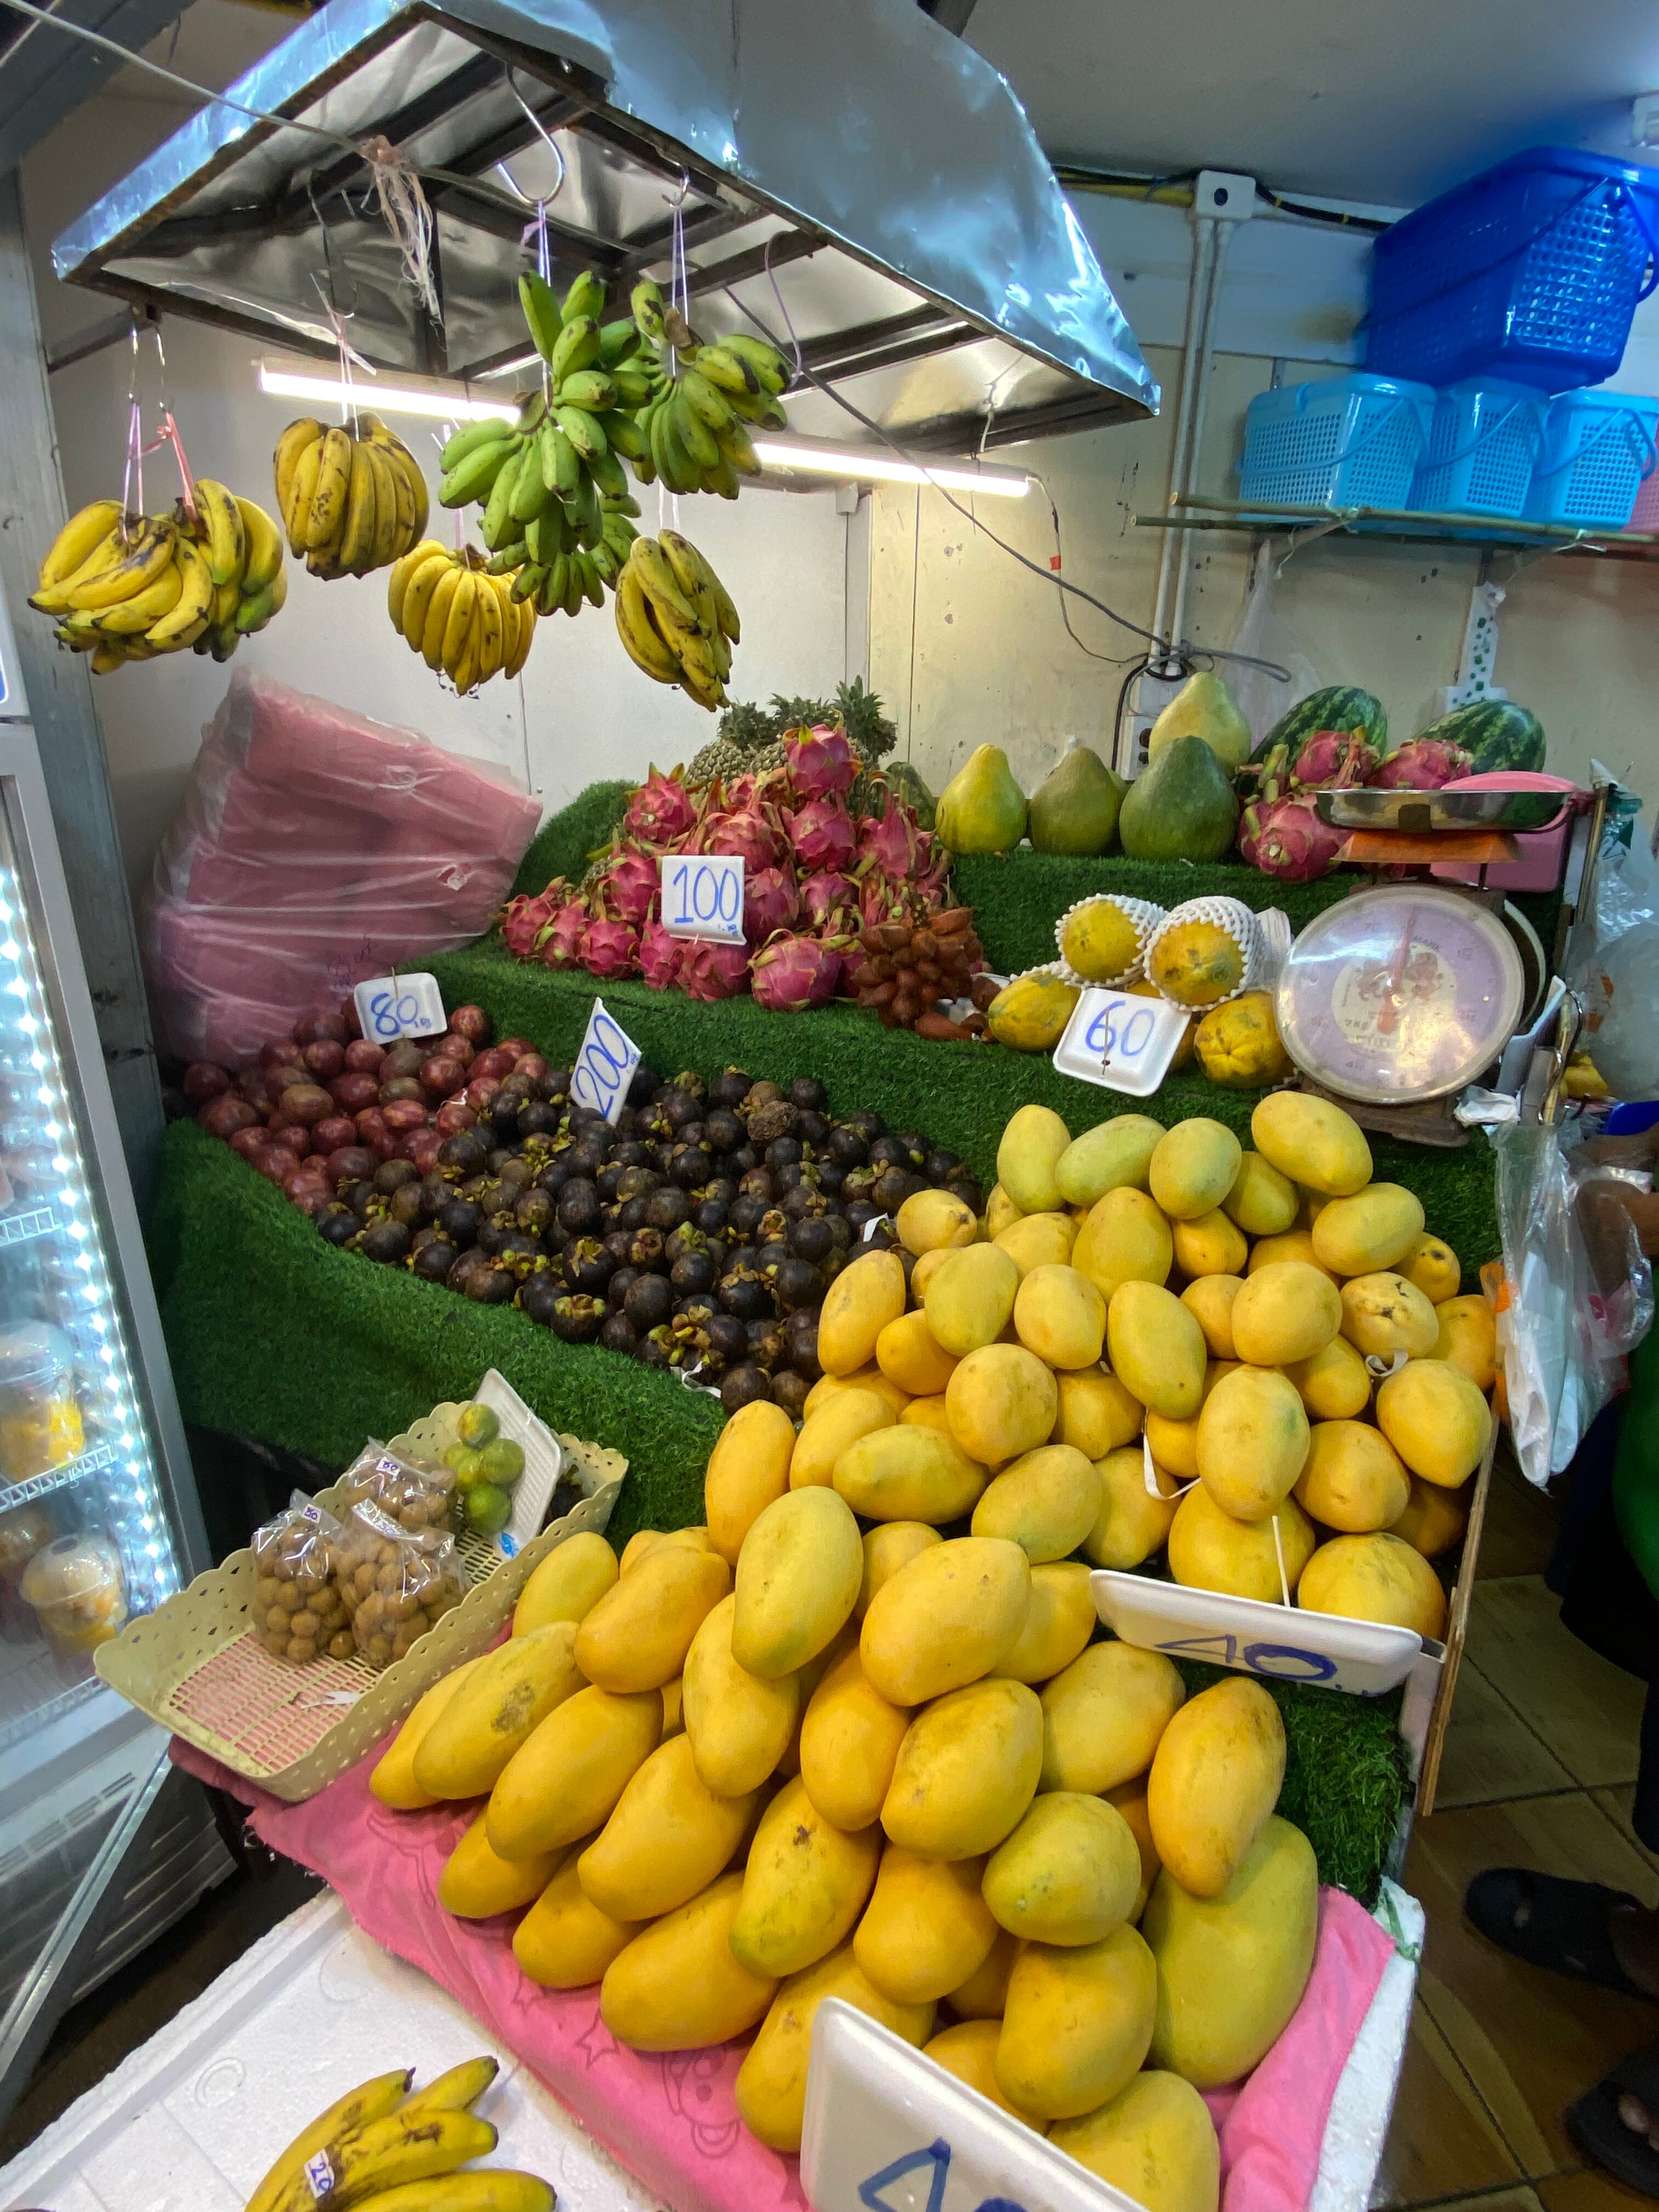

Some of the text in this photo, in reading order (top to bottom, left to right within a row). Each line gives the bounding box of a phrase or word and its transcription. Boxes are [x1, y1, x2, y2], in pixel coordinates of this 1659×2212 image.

[673, 865, 740, 923] 100
[371, 992, 418, 1035] 80
[1085, 1000, 1155, 1056] 60
[575, 1015, 628, 1120] 200
[1154, 1635, 1337, 1680] 40
[311, 2162, 332, 2192] 20
